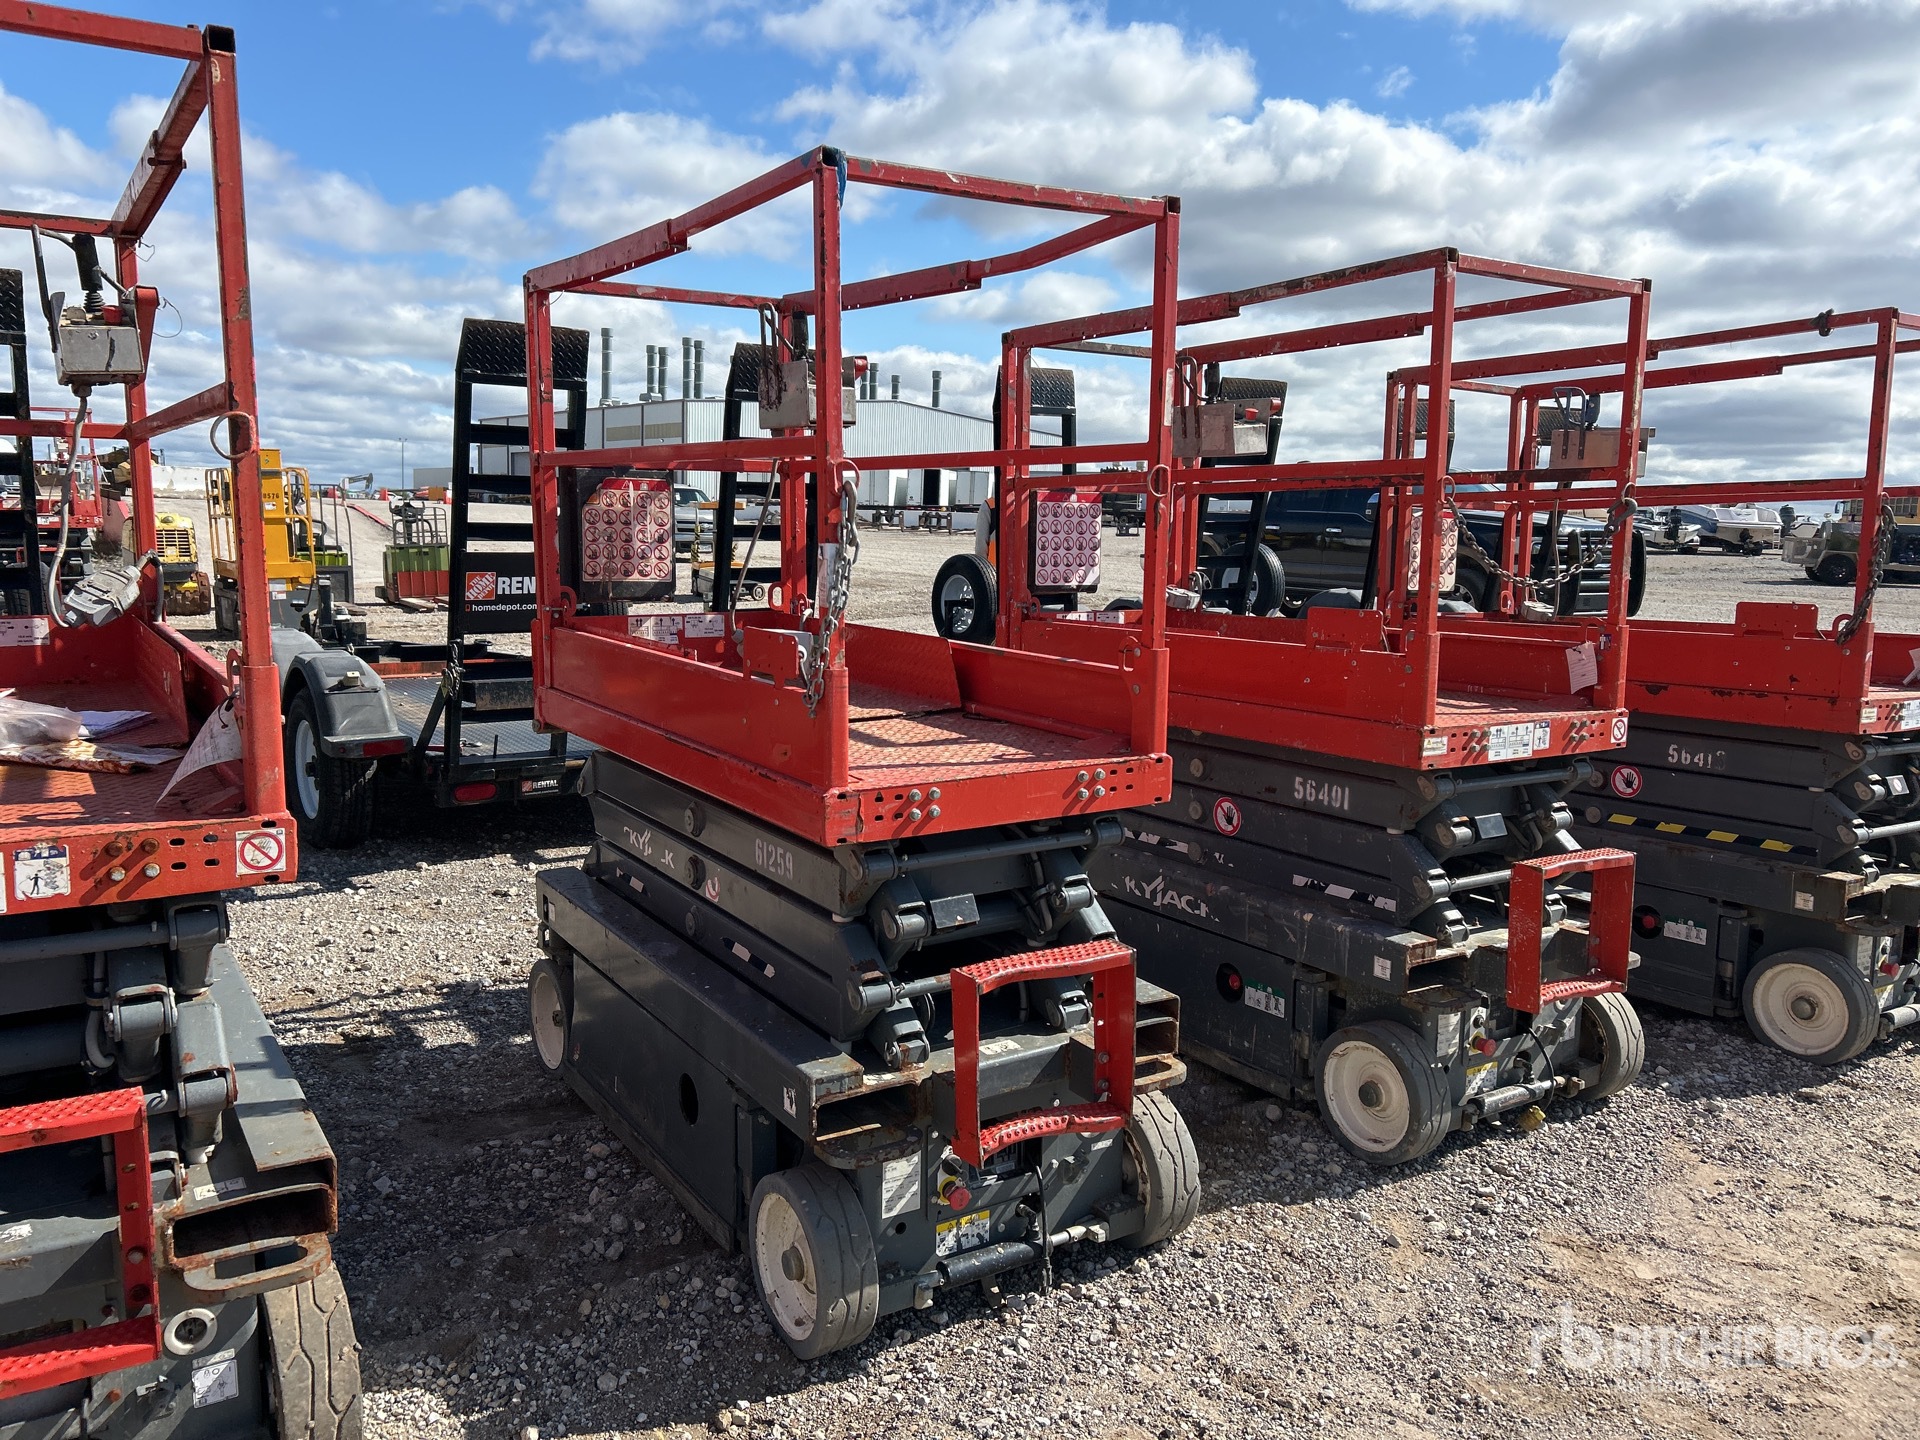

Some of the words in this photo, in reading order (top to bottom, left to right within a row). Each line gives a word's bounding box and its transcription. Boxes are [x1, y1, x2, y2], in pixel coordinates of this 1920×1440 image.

[466, 572, 496, 600] HOME
[469, 575, 482, 587] THE
[532, 780, 558, 789] RENTAL
[1293, 776, 1350, 811] 56401
[755, 838, 794, 881] 61259
